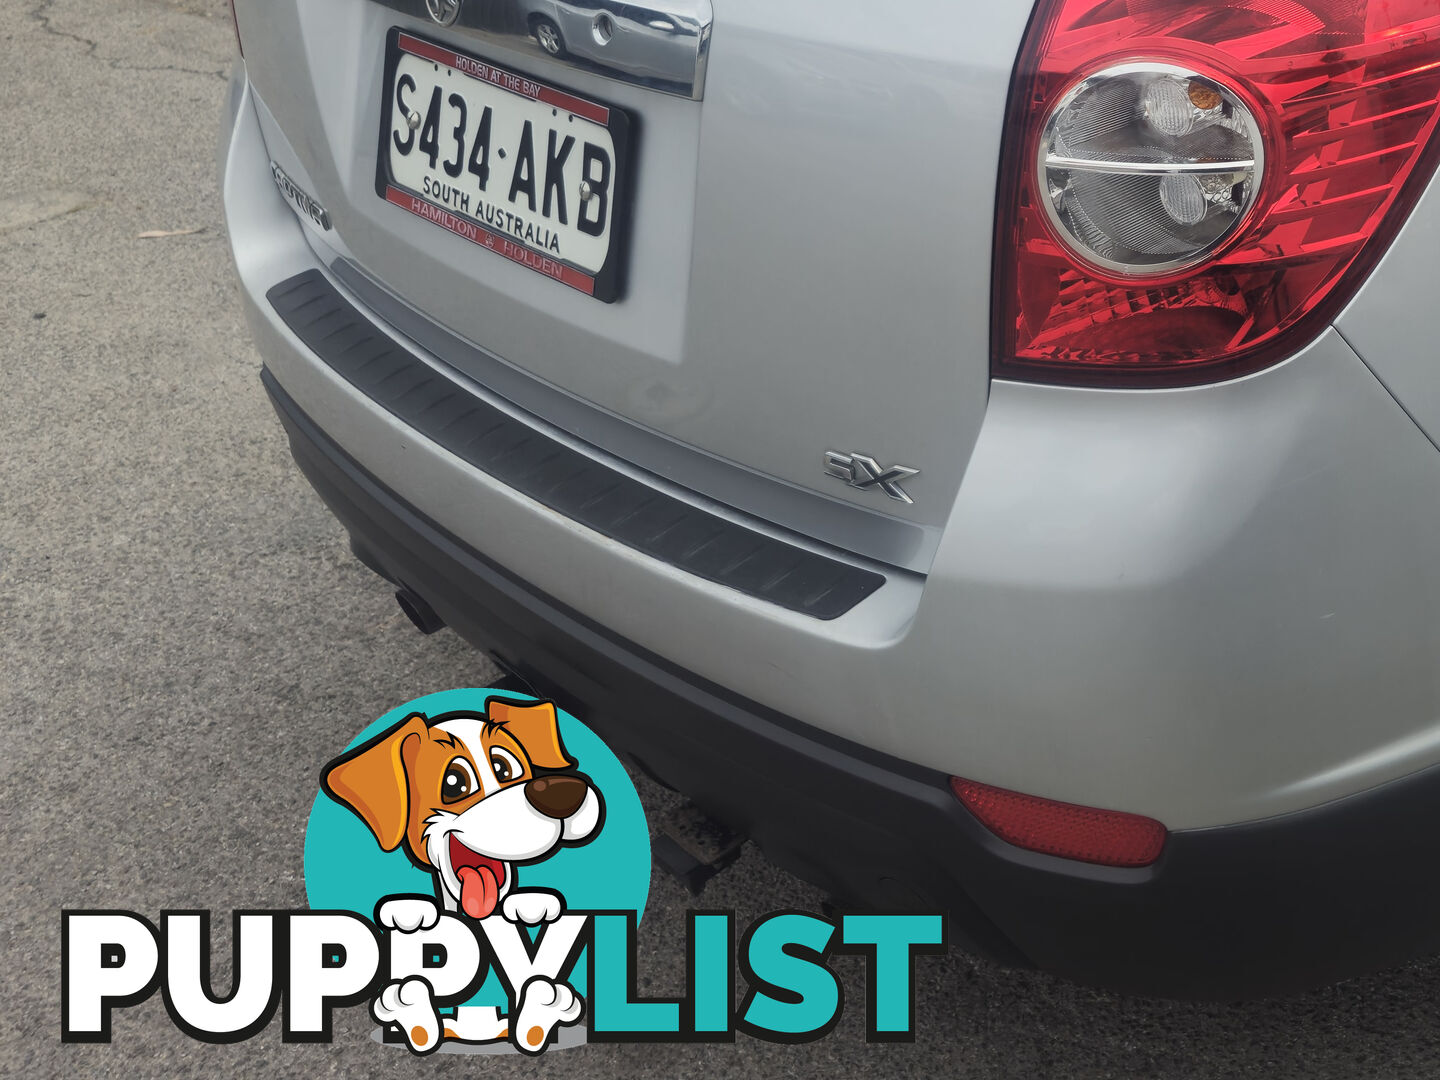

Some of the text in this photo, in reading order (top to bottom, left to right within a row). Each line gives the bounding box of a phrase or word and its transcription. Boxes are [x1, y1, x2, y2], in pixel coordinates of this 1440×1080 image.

[455, 55, 541, 98] HOLDEN AT THE BAY
[411, 198, 563, 279] HAMILTON HOLDEN
[423, 175, 560, 254] SOUTH AUSTRALIA
